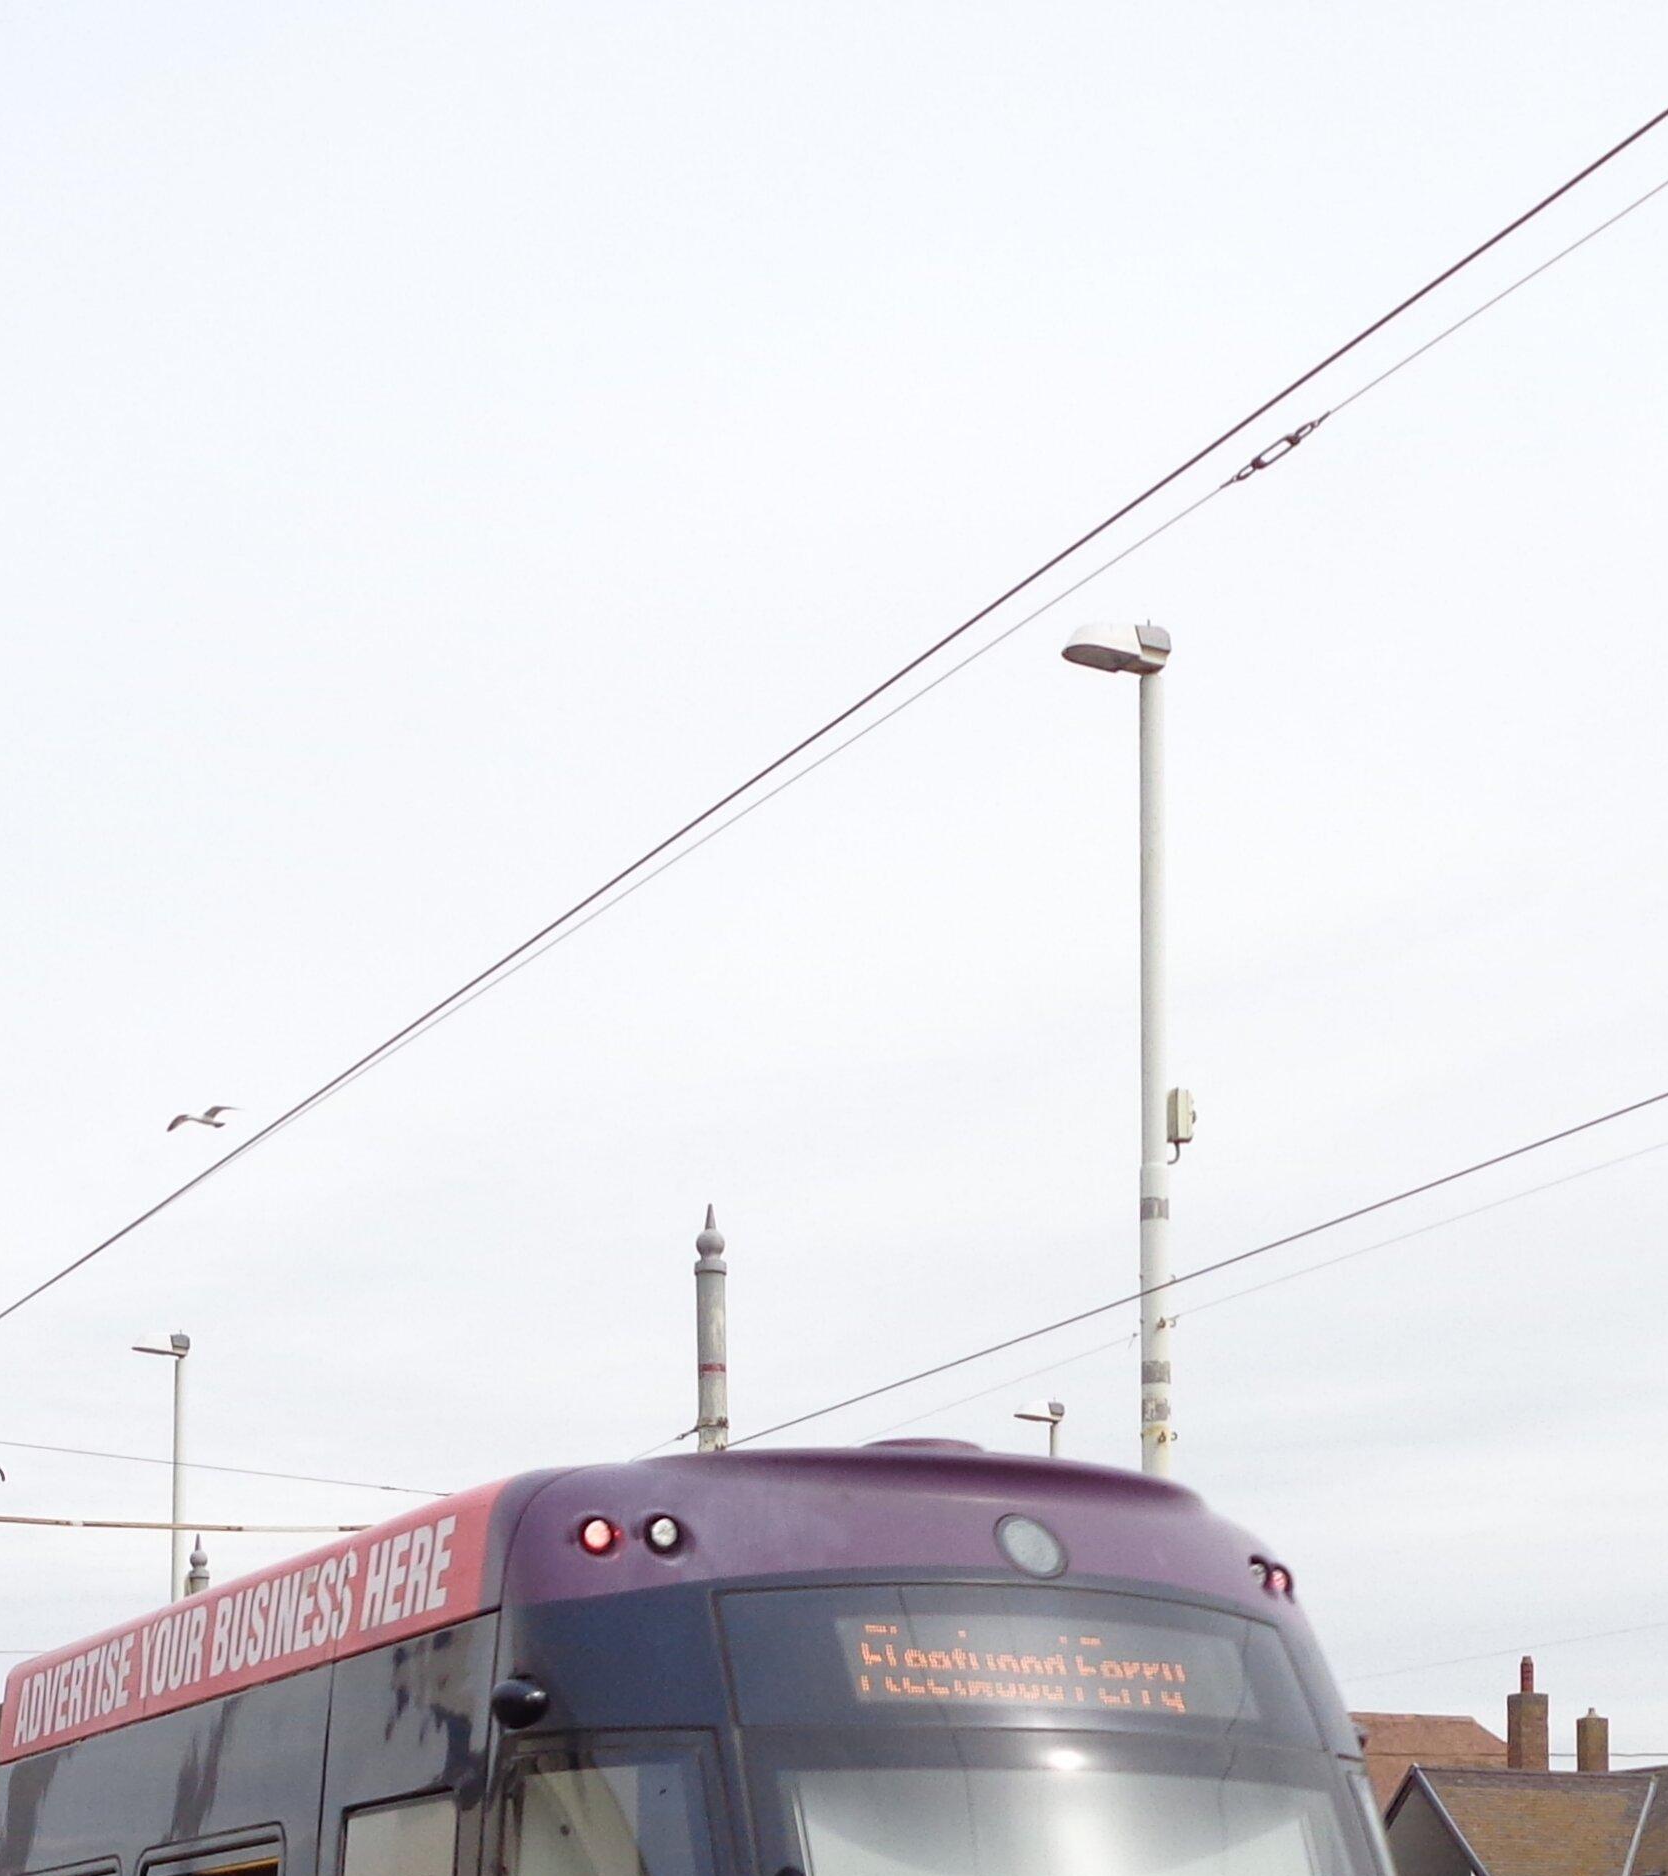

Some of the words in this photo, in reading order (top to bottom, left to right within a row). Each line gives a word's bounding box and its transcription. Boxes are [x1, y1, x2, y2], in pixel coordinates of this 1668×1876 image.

[13, 1634, 134, 1748] ADVERTISE
[139, 1606, 208, 1700] YOUR
[210, 1546, 358, 1676] BUSINESS
[360, 1514, 457, 1632] HERE
